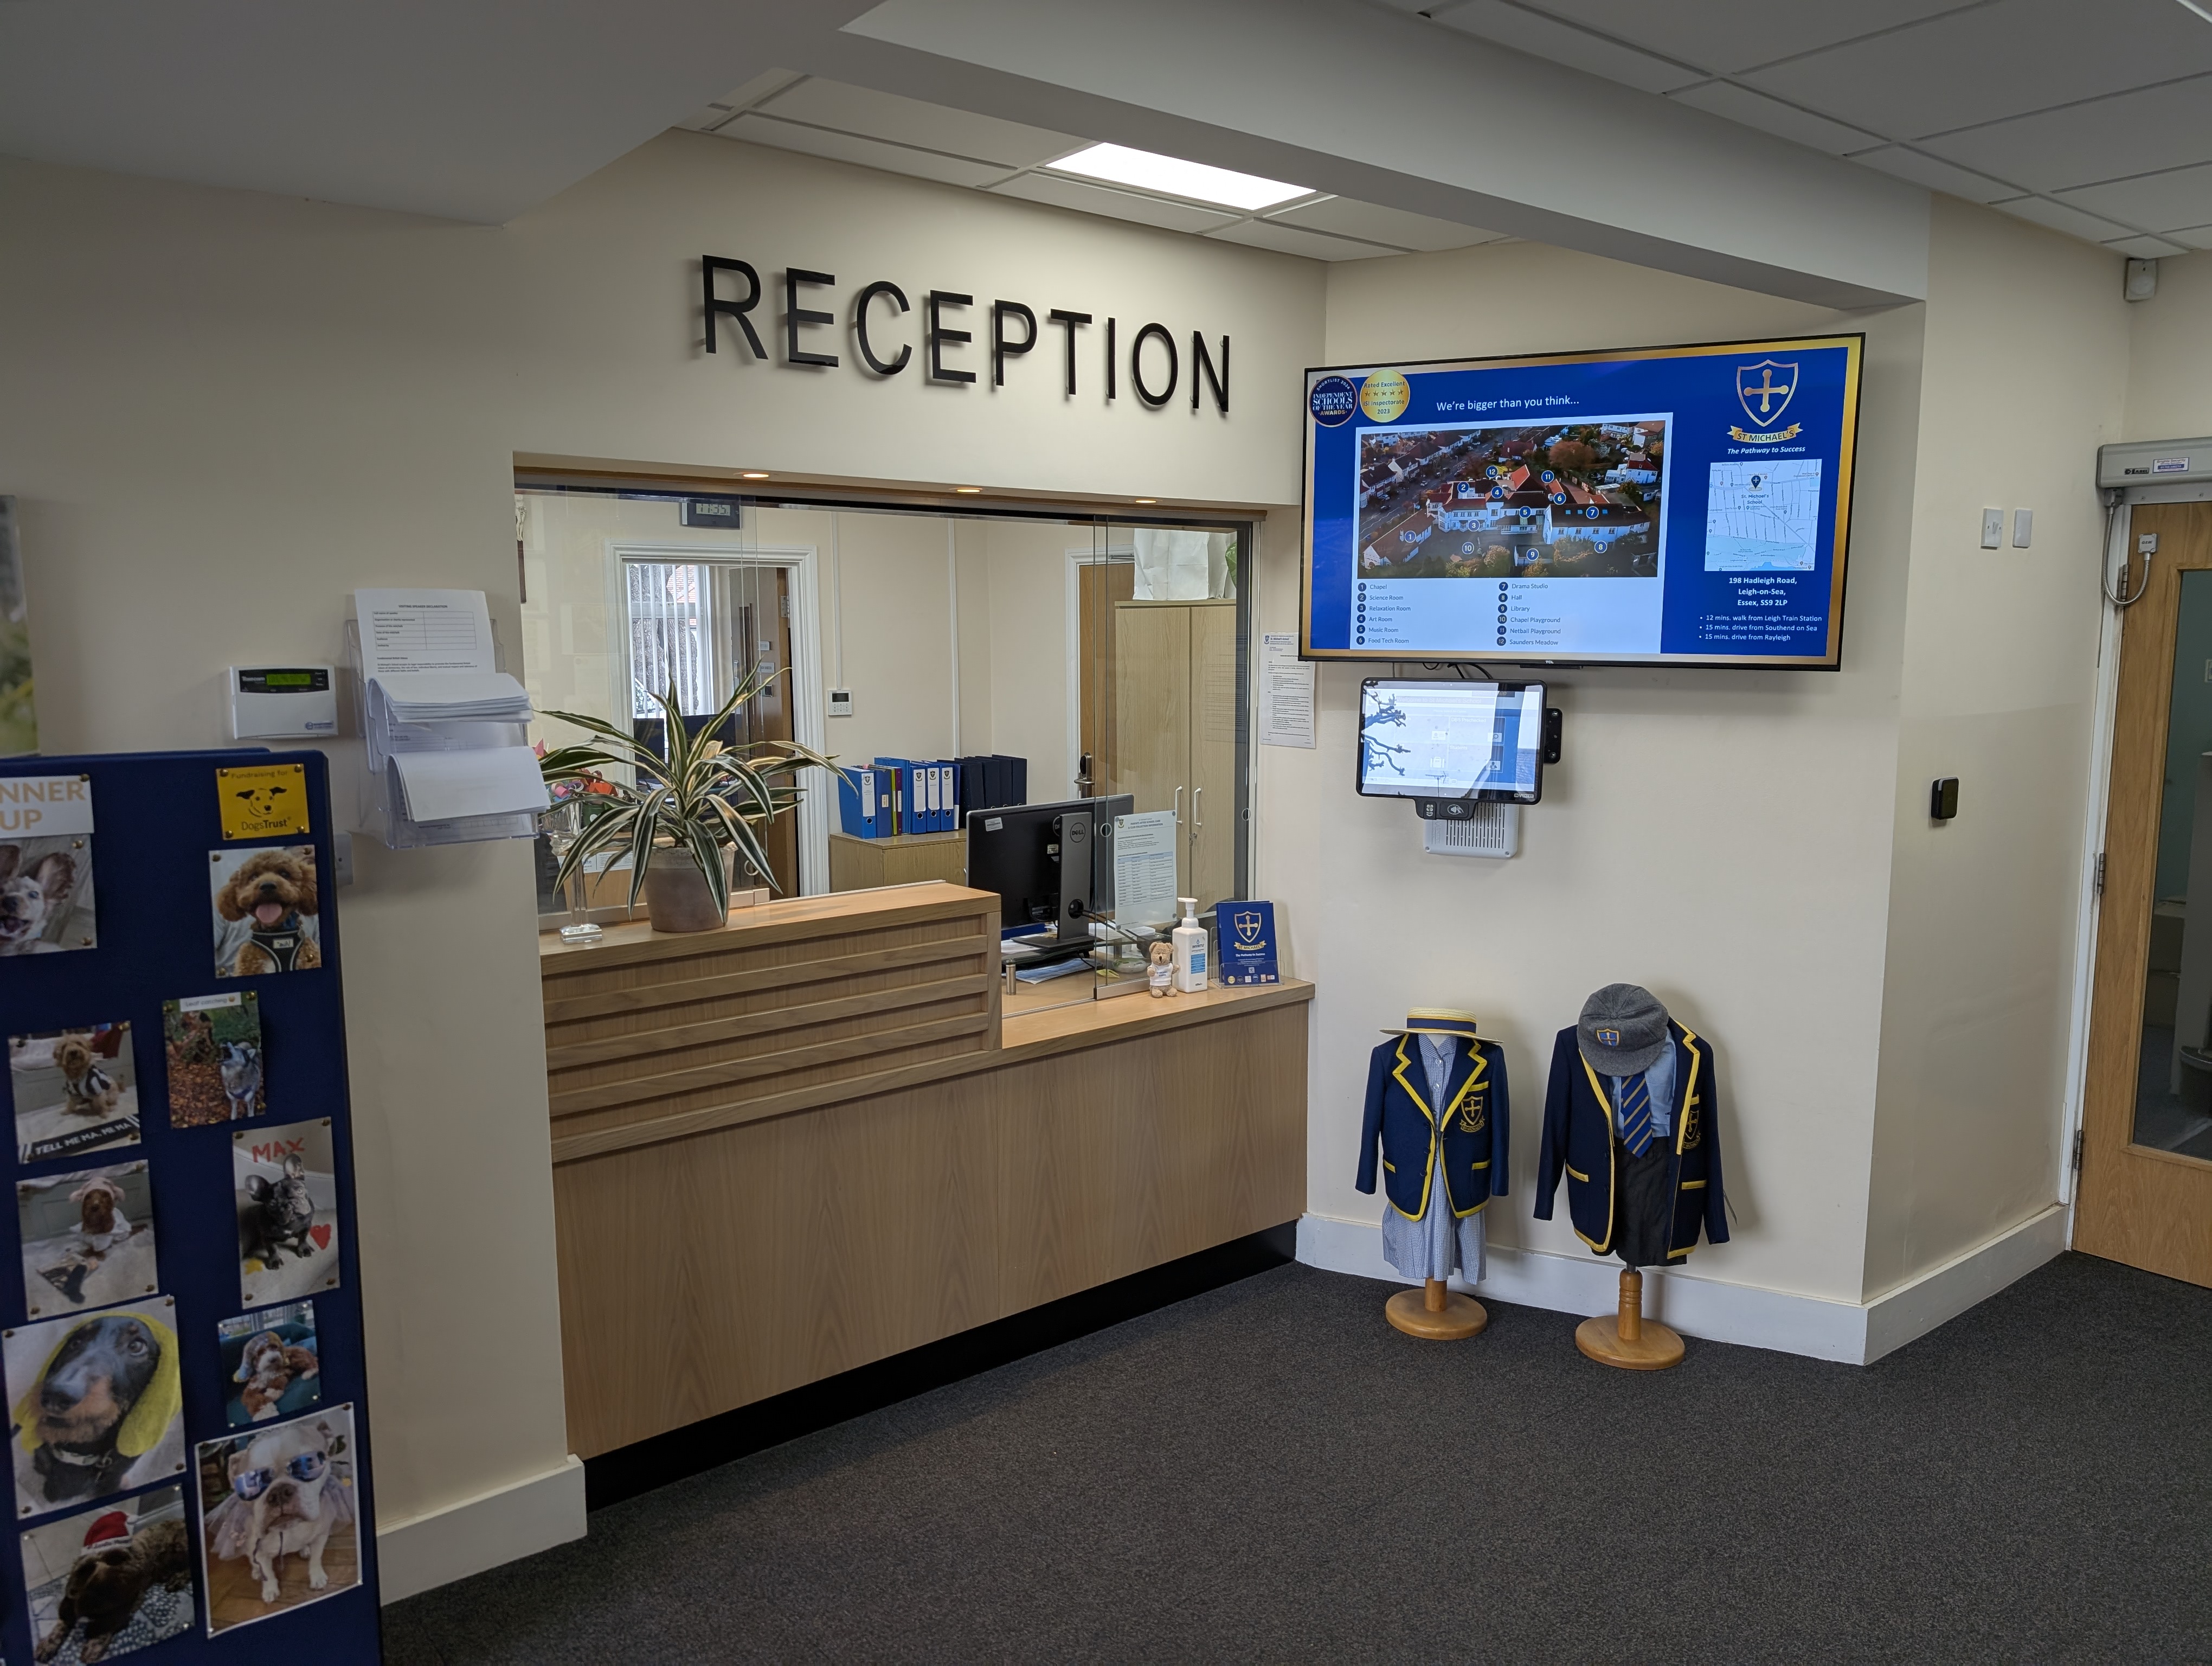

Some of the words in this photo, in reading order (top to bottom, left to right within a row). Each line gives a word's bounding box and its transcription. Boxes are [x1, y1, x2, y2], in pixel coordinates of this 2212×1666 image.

[703, 255, 1230, 412] RECEPTION
[1316, 378, 1339, 391] SHORTLIST
[1341, 379, 1351, 390] 2024
[1313, 397, 1353, 405] SCHOOLS
[1468, 400, 1497, 411] bigger
[1500, 399, 1521, 407] than
[1525, 398, 1542, 408] you
[1545, 395, 1579, 406] think...
[1748, 430, 1794, 441] MICHAEL'S
[0, 809, 43, 832] UP
[241, 819, 287, 831] DogsTrust
[36, 1142, 63, 1155] TELL
[65, 1137, 80, 1146] ME
[101, 1126, 115, 1135] ME
[252, 1137, 305, 1163] MAX
